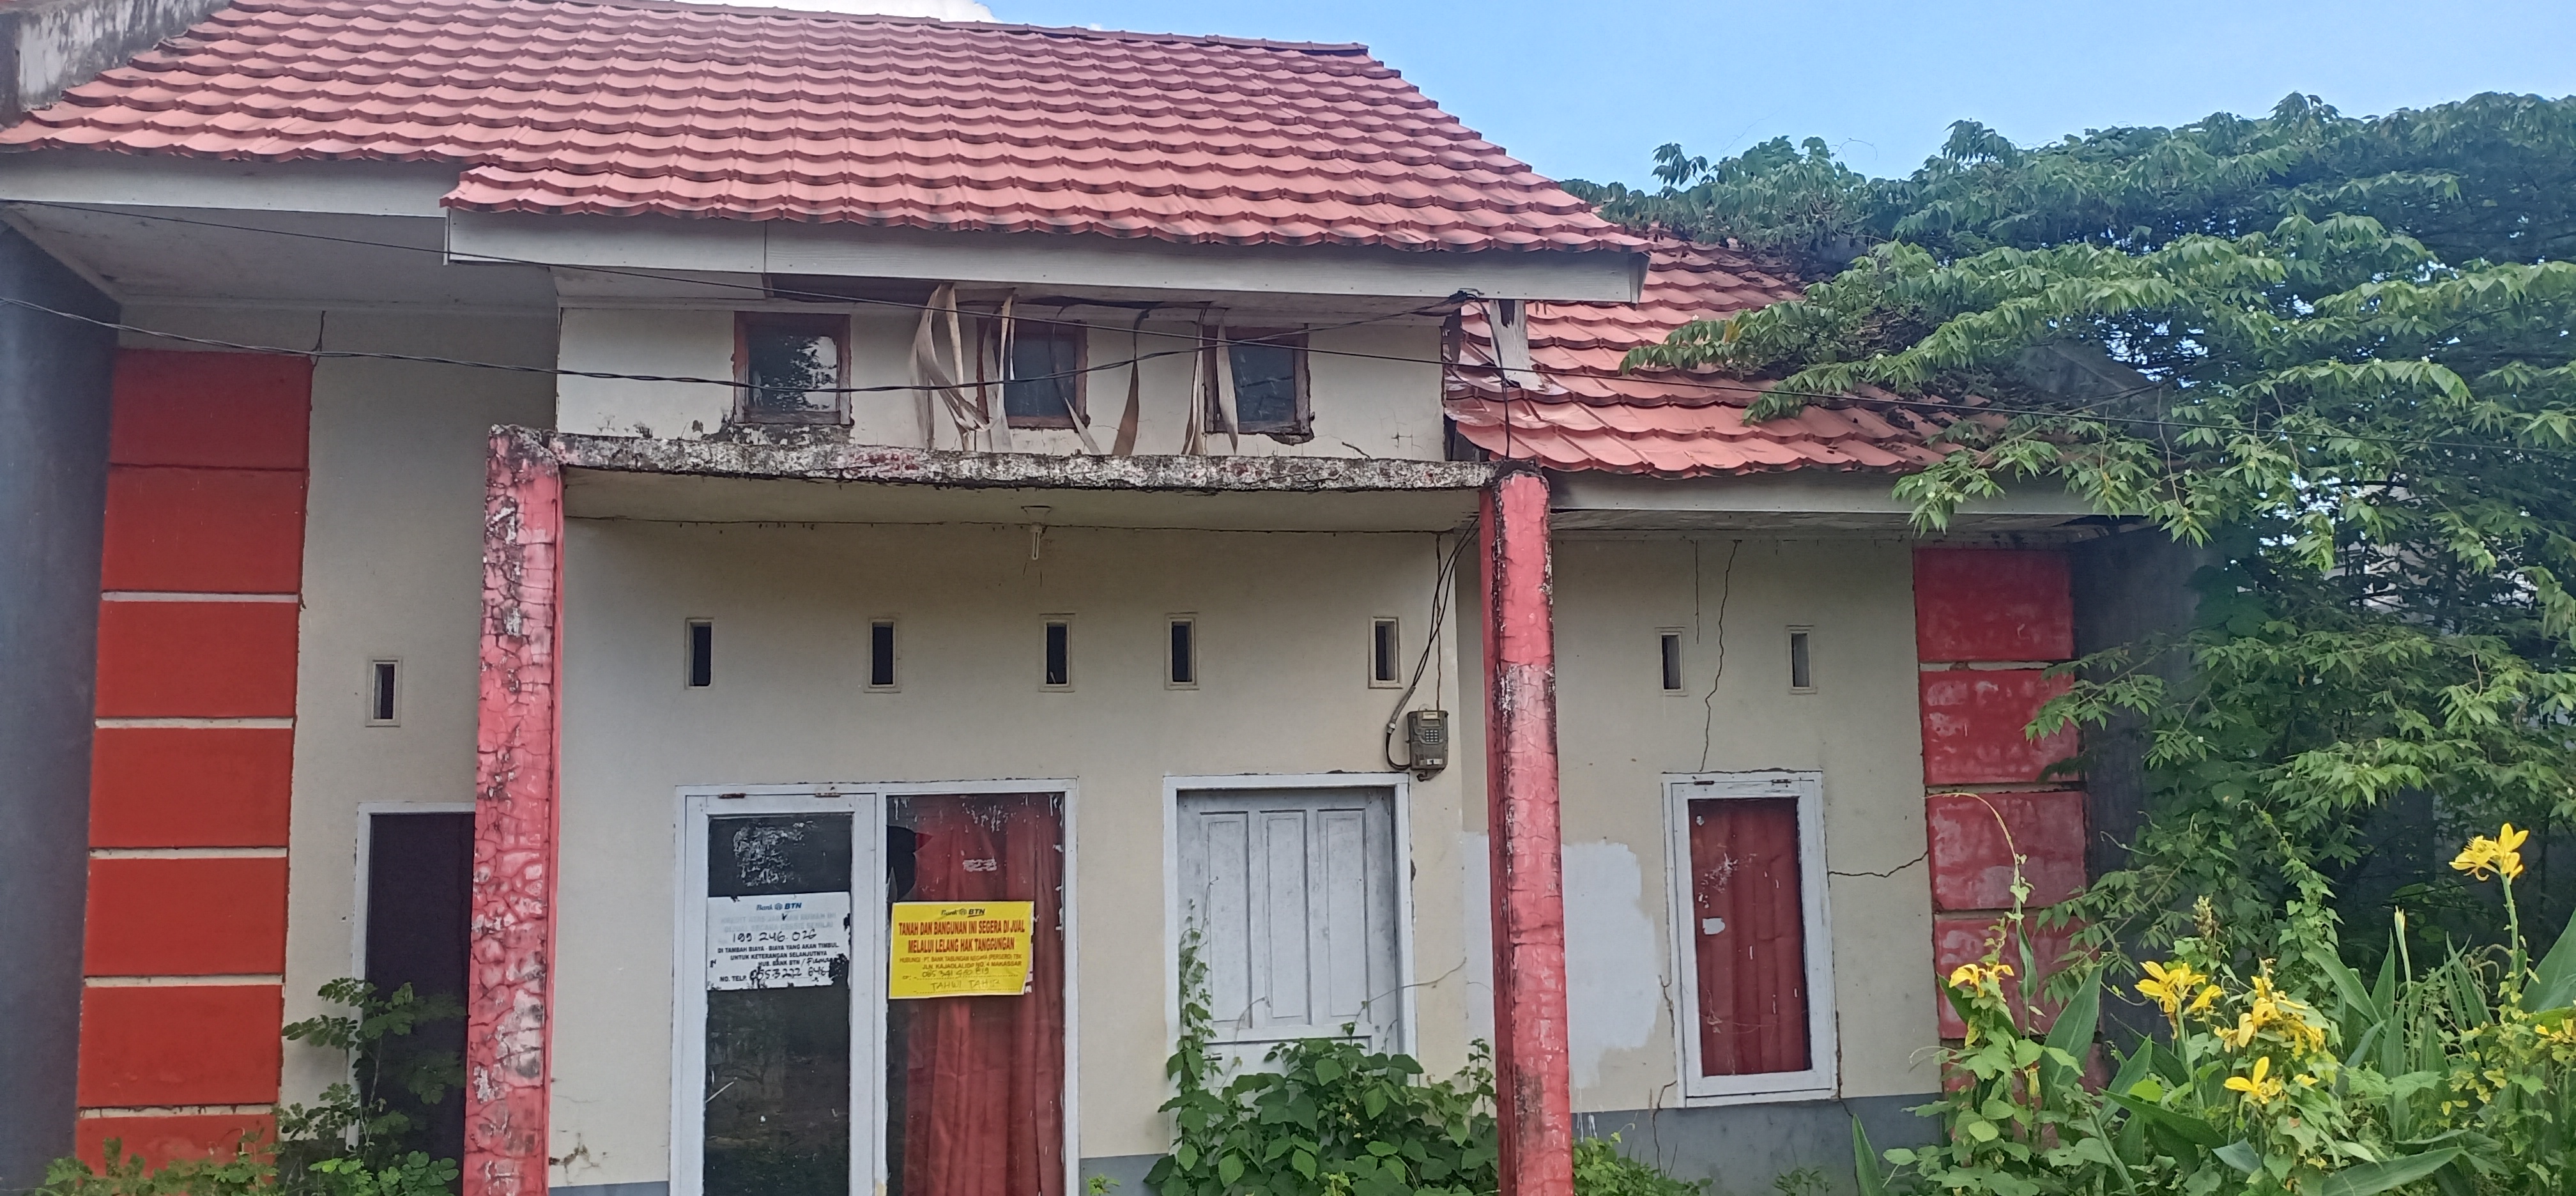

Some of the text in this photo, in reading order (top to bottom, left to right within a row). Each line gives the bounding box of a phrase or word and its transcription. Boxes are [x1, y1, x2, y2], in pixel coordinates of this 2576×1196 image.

[899, 919, 1025, 935] TANAH DAN BANGUNAN INI SEGERA DI JUAL
[908, 937, 1015, 953] MELALUI LELANG HAK TANGGUNGAN
